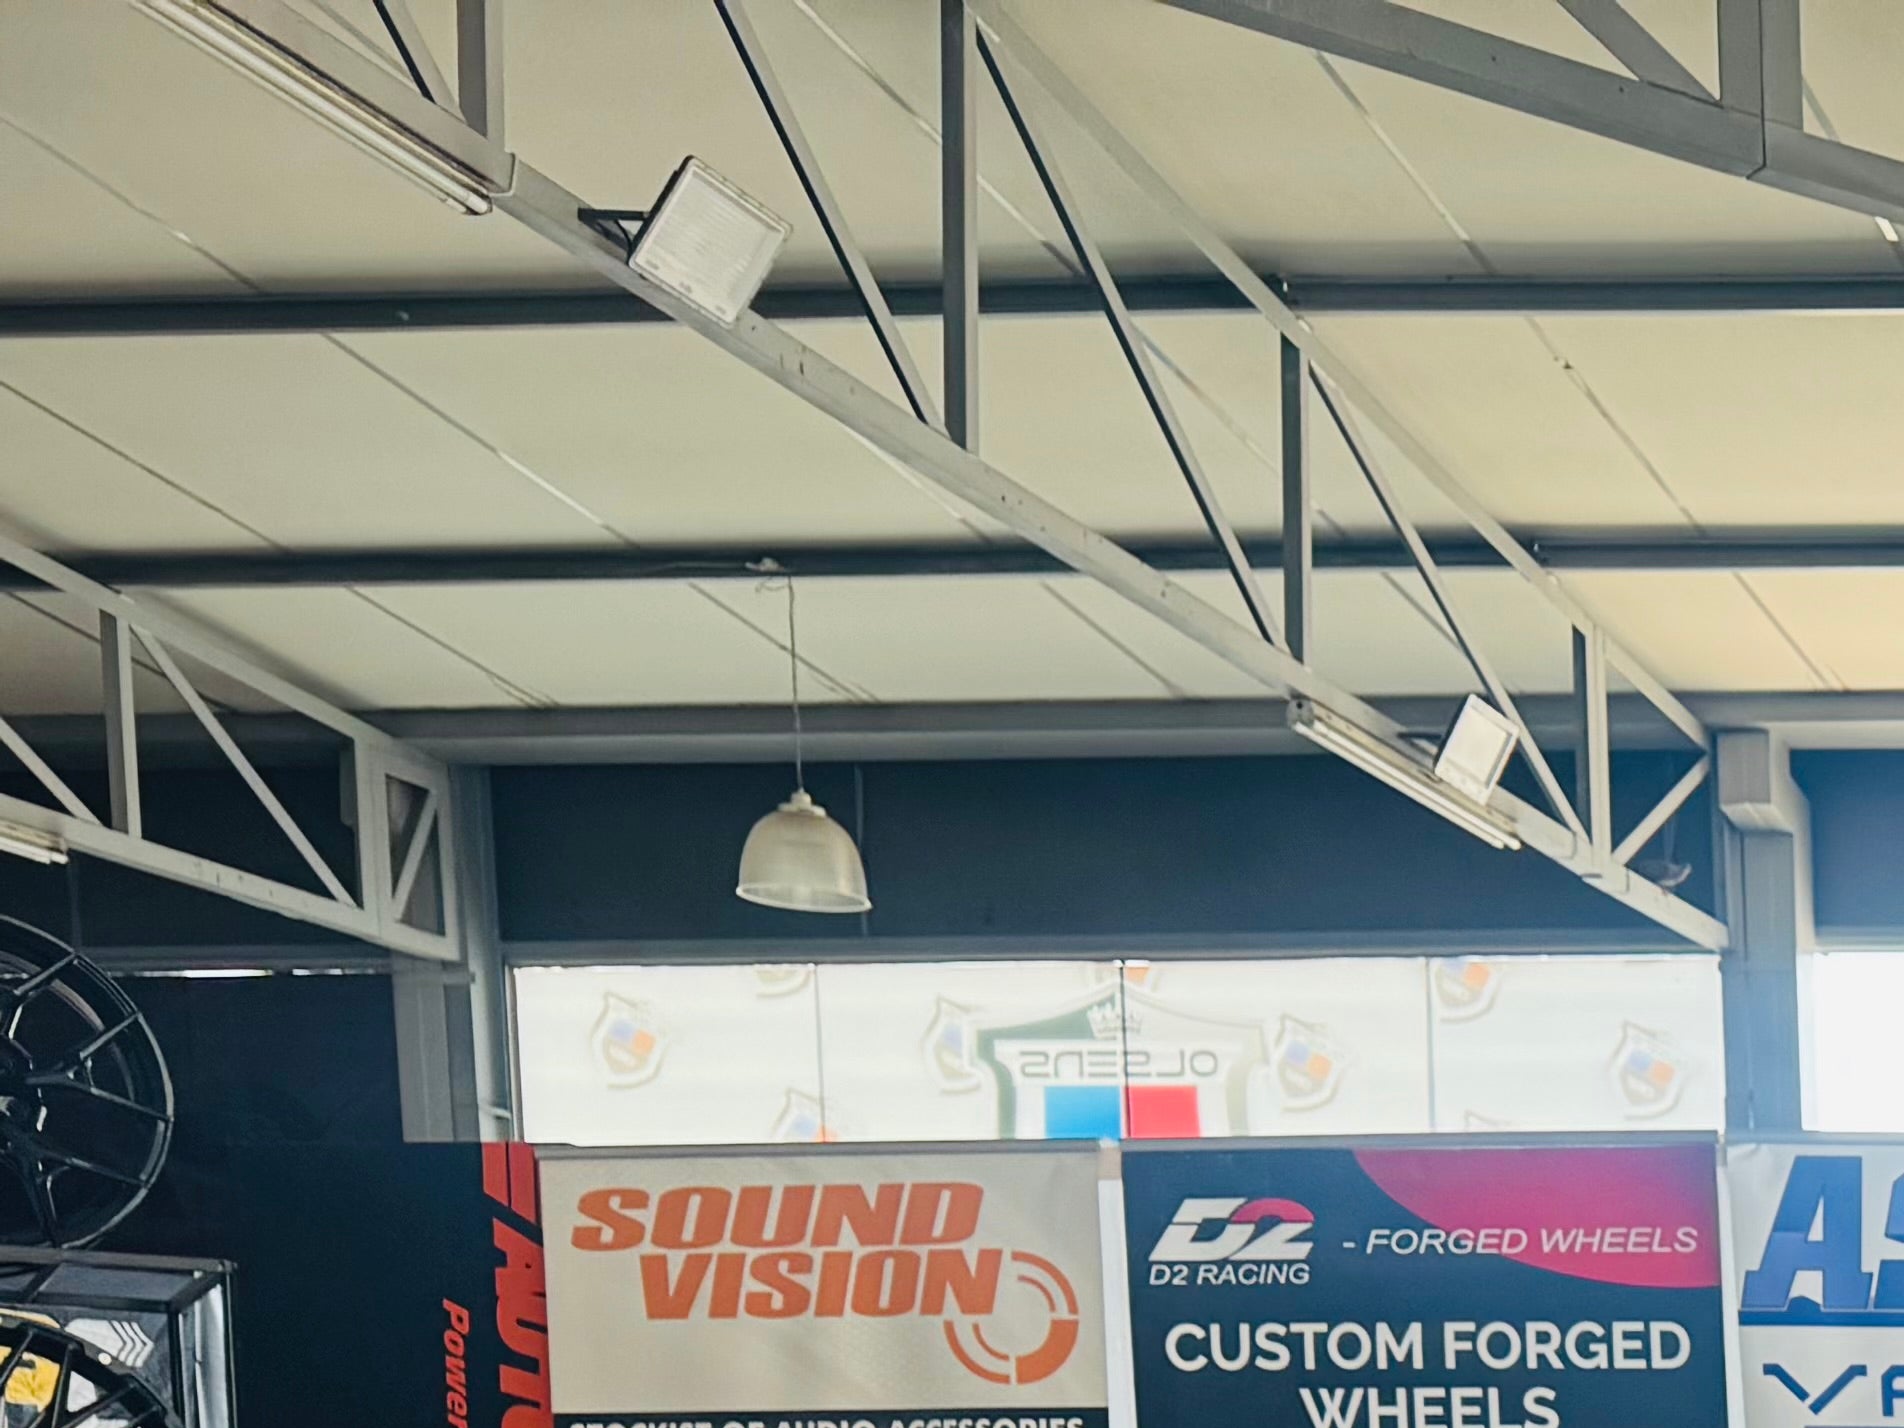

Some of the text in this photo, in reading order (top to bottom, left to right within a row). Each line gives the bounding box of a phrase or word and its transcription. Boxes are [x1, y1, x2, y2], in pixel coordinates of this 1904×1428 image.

[570, 1182, 984, 1252] SOUND
[1365, 1226, 1699, 1255] FORGED WHEELS
[639, 1248, 1003, 1321] VISION
[1148, 1263, 1312, 1286] D2 RACING
[1164, 1320, 1691, 1372] CUSTOM FORGED
